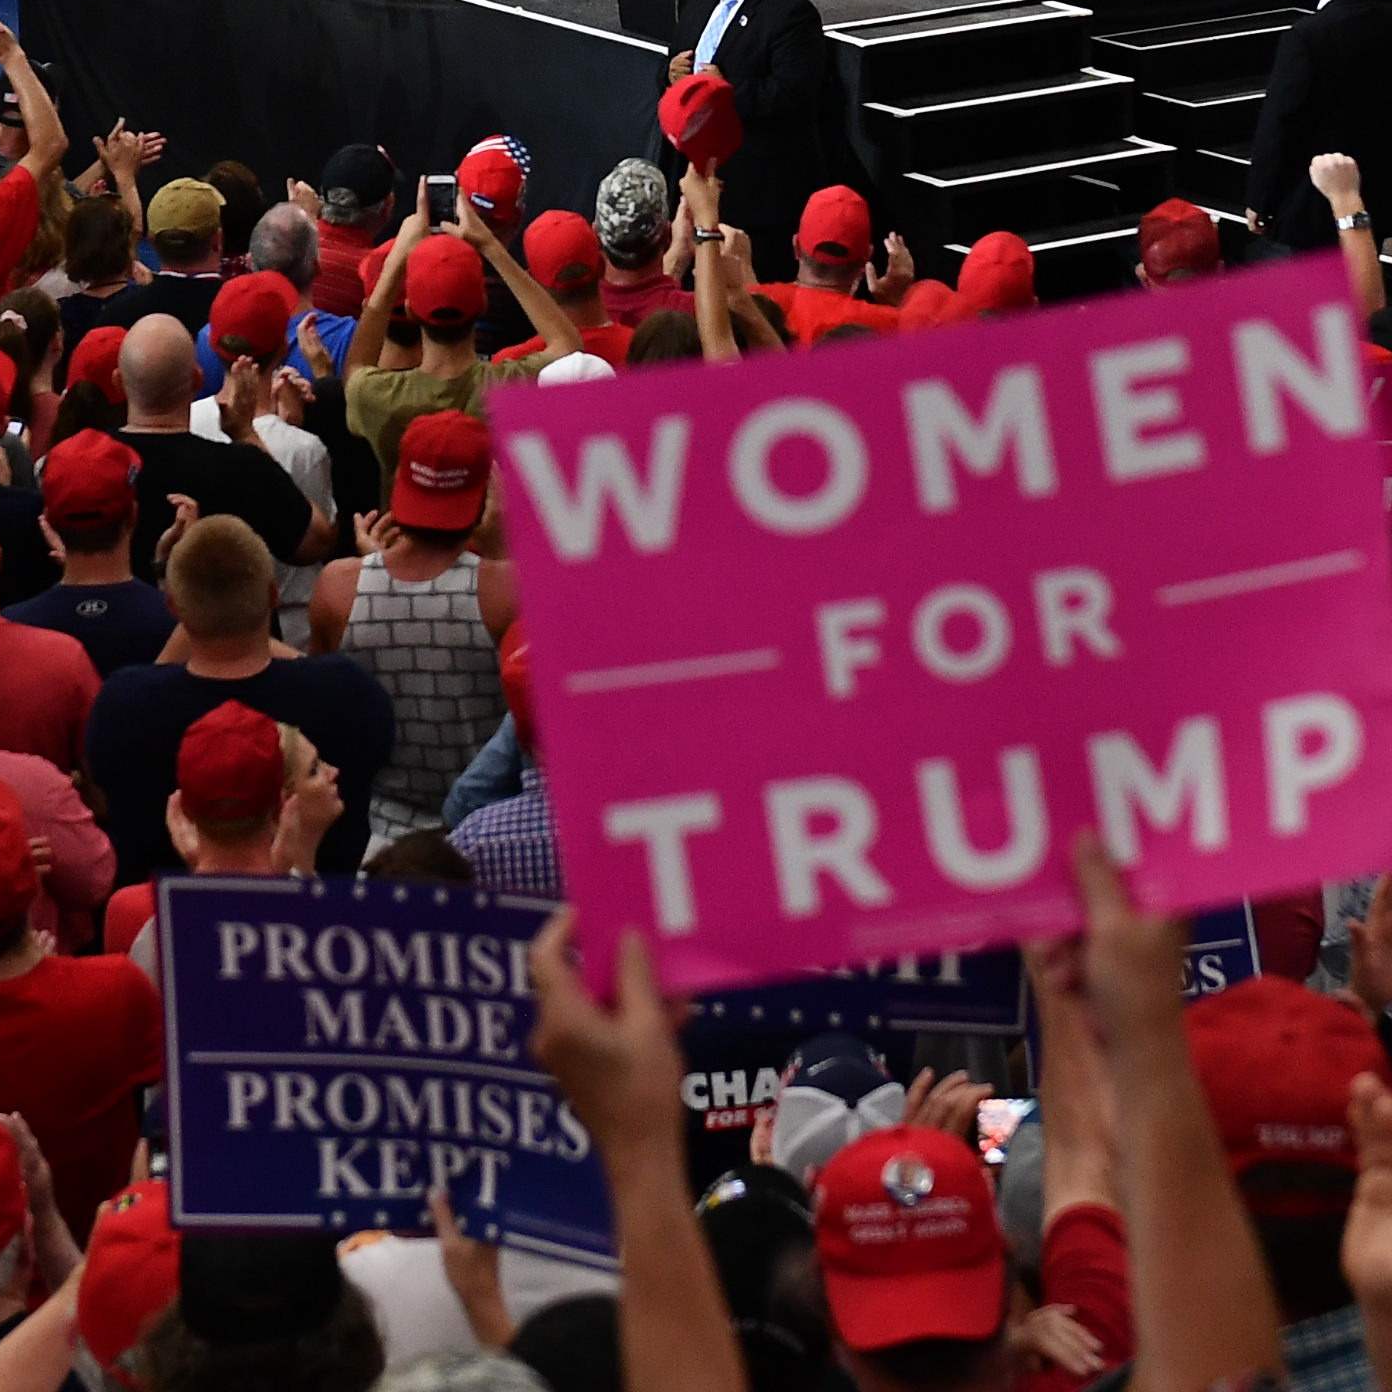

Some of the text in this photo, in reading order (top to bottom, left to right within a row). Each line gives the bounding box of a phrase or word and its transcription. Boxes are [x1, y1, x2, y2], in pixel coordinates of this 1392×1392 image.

[508, 301, 1372, 565] WOMEN
[815, 566, 1124, 701] FOR
[603, 690, 1366, 936] TRUMP
[305, 986, 517, 1061] MADE
[226, 1069, 592, 1161] PROMISES
[706, 1108, 749, 1129] FOR
[316, 1135, 509, 1207] KEPT
